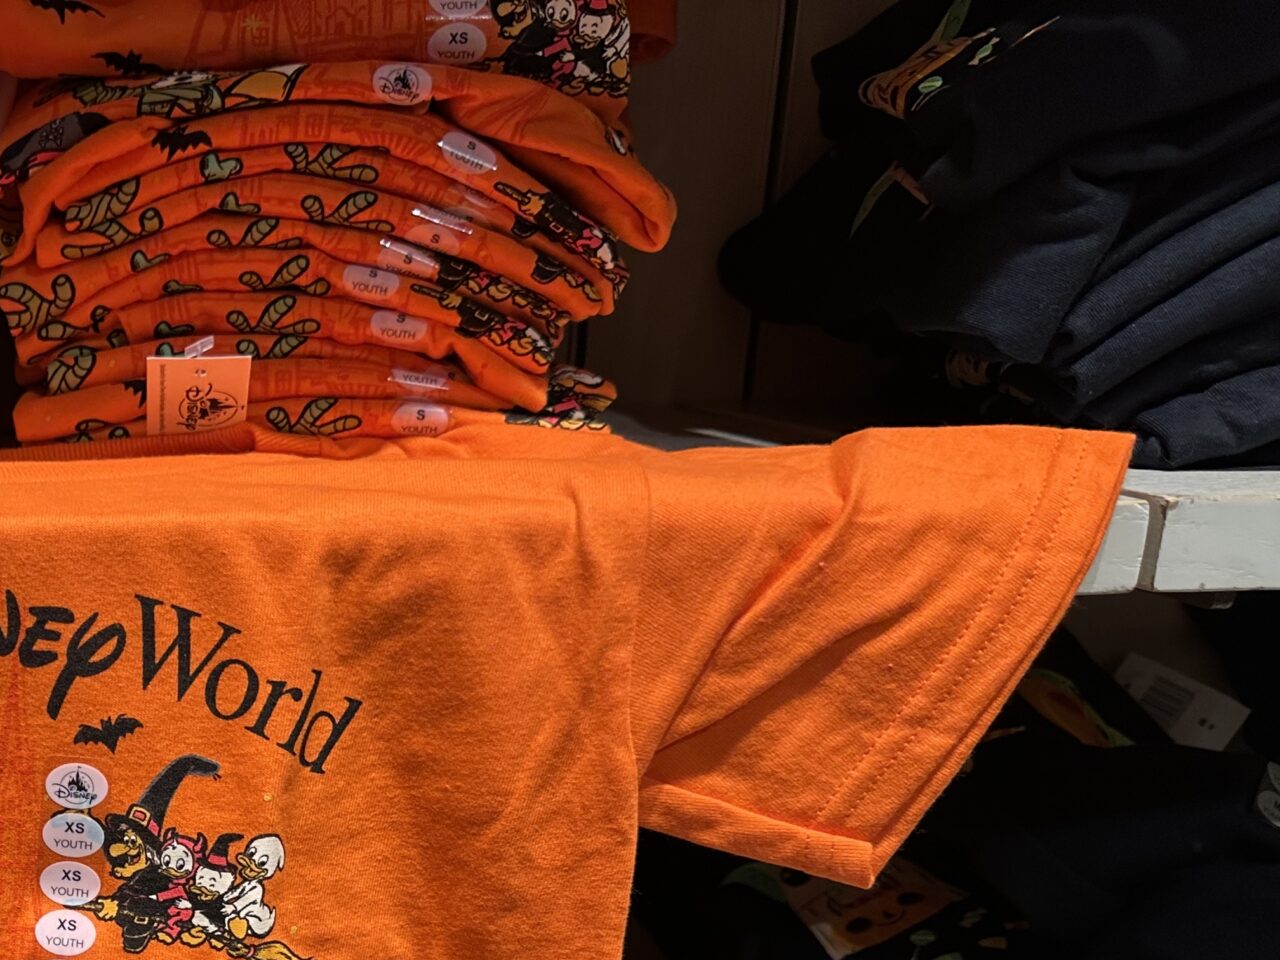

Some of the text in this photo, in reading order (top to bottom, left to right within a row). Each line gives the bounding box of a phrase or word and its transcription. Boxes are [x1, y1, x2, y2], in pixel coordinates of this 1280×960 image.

[440, 1, 478, 11] YOUTH
[448, 32, 469, 46] XS
[437, 50, 476, 60] YOUTH
[430, 233, 441, 244] S
[368, 268, 378, 279] S
[351, 281, 388, 296] YOUTH
[380, 327, 417, 340] YOUTH
[402, 373, 439, 385] YOUTH
[415, 409, 426, 422] S
[400, 425, 439, 435] YOUTH
[133, 593, 363, 775] World
[64, 821, 86, 834] XS
[53, 838, 94, 851] YOUTH
[61, 869, 82, 882] XS
[50, 886, 90, 898] YOUTH
[57, 918, 78, 931] XS
[45, 935, 85, 949] YOUTH
